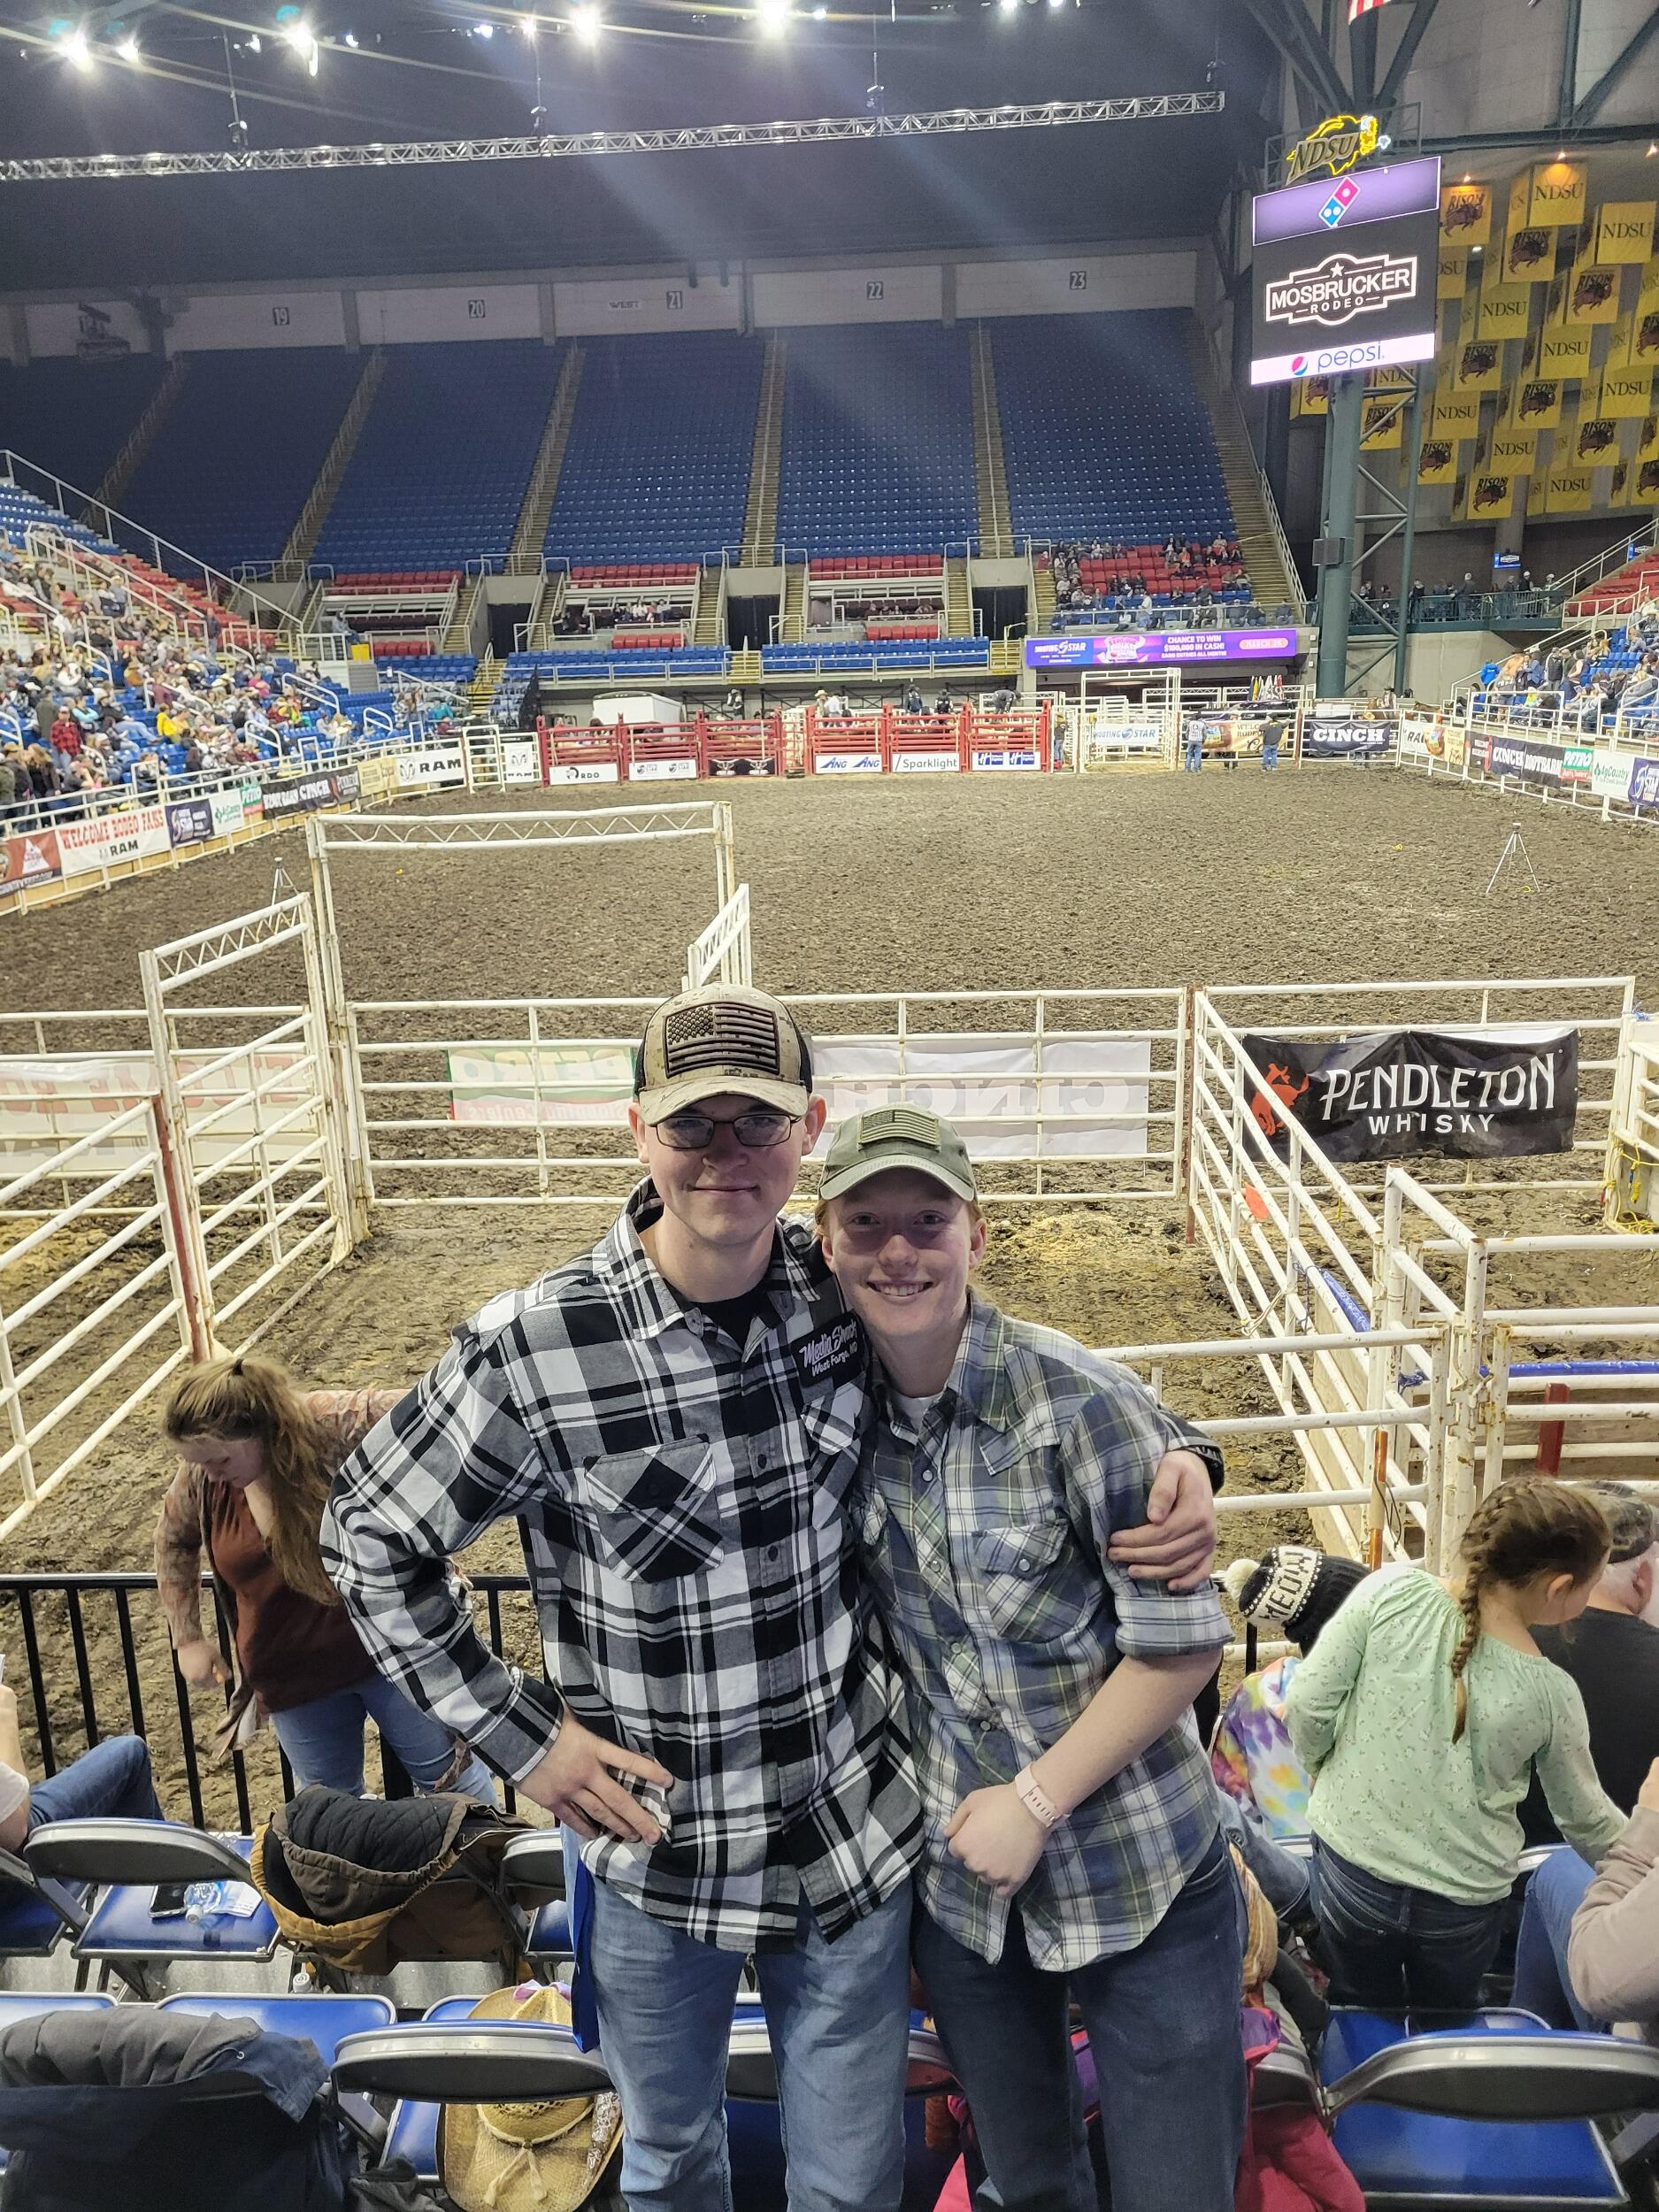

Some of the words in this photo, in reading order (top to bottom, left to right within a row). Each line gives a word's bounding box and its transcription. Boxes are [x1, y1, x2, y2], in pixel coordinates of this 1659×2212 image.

[1292, 135, 1354, 177] NDSU
[1535, 183, 1584, 201] NDSU
[1448, 193, 1486, 211] BISON
[1602, 221, 1652, 239] NDSU
[1513, 230, 1552, 249] BISON
[1071, 272, 1086, 289] 23
[1271, 268, 1410, 310] MOSBRUCKER
[1576, 273, 1615, 291] BISON
[868, 282, 882, 299] 22
[668, 292, 681, 309] 21
[1310, 296, 1363, 313] RODEO
[274, 309, 289, 326] 19
[469, 301, 484, 318] 20
[1481, 302, 1526, 317] NDSU
[1317, 342, 1382, 373] pepsi
[1464, 345, 1499, 361] BISON
[1544, 342, 1589, 357] NDSU
[1525, 380, 1558, 396] BISON
[1605, 381, 1650, 396] NDSU
[1436, 405, 1478, 420] NDSU
[1582, 420, 1617, 436] BISON
[1421, 442, 1454, 457] BISON
[1494, 442, 1534, 456] NDSU
[1478, 476, 1509, 488] BISON
[1550, 478, 1593, 492] NDSU
[1067, 641, 1087, 651] STAR
[1164, 644, 1194, 653] $100,000
[1133, 729, 1156, 738] STAR
[1313, 728, 1385, 743] CINCH
[902, 757, 957, 770] Sparklight
[1493, 746, 1524, 766] CINCH
[1563, 751, 1592, 766] PETRO
[419, 758, 462, 773] RAM
[59, 819, 110, 849] WELCOME
[113, 816, 140, 838] RODEO
[142, 808, 165, 831] FANS
[111, 840, 139, 856] RAM
[1320, 1053, 1555, 1121] PENDLETON
[1368, 1112, 1495, 1135] WHISKY
[811, 1359, 831, 1377] West
[1257, 1550, 1313, 1620] MEOW
